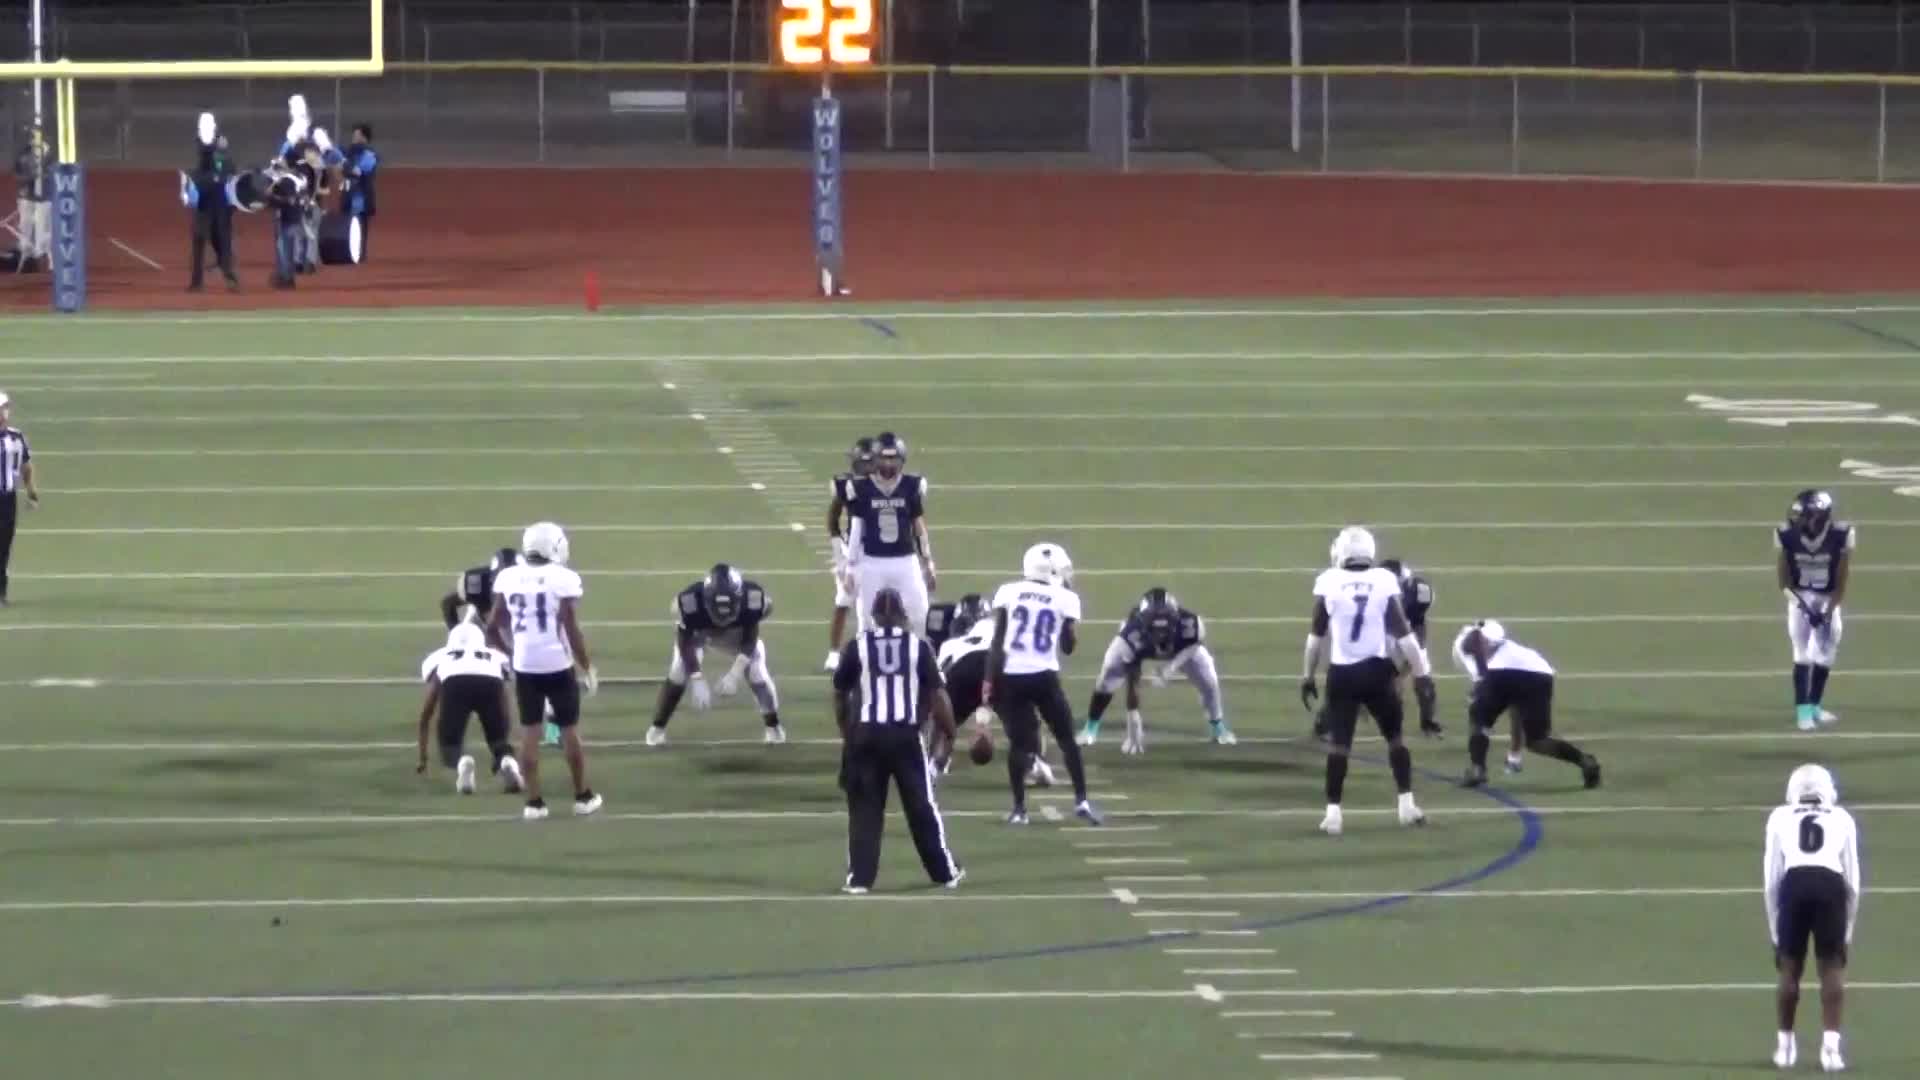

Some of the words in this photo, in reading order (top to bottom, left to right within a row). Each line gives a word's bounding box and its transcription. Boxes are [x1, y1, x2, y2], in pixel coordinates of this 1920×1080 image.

[781, 0, 872, 63] 22
[509, 592, 547, 633] 21
[1010, 605, 1056, 653] 20
[1350, 594, 1368, 642] 7
[874, 638, 902, 673] U
[1799, 814, 1824, 853] 6
